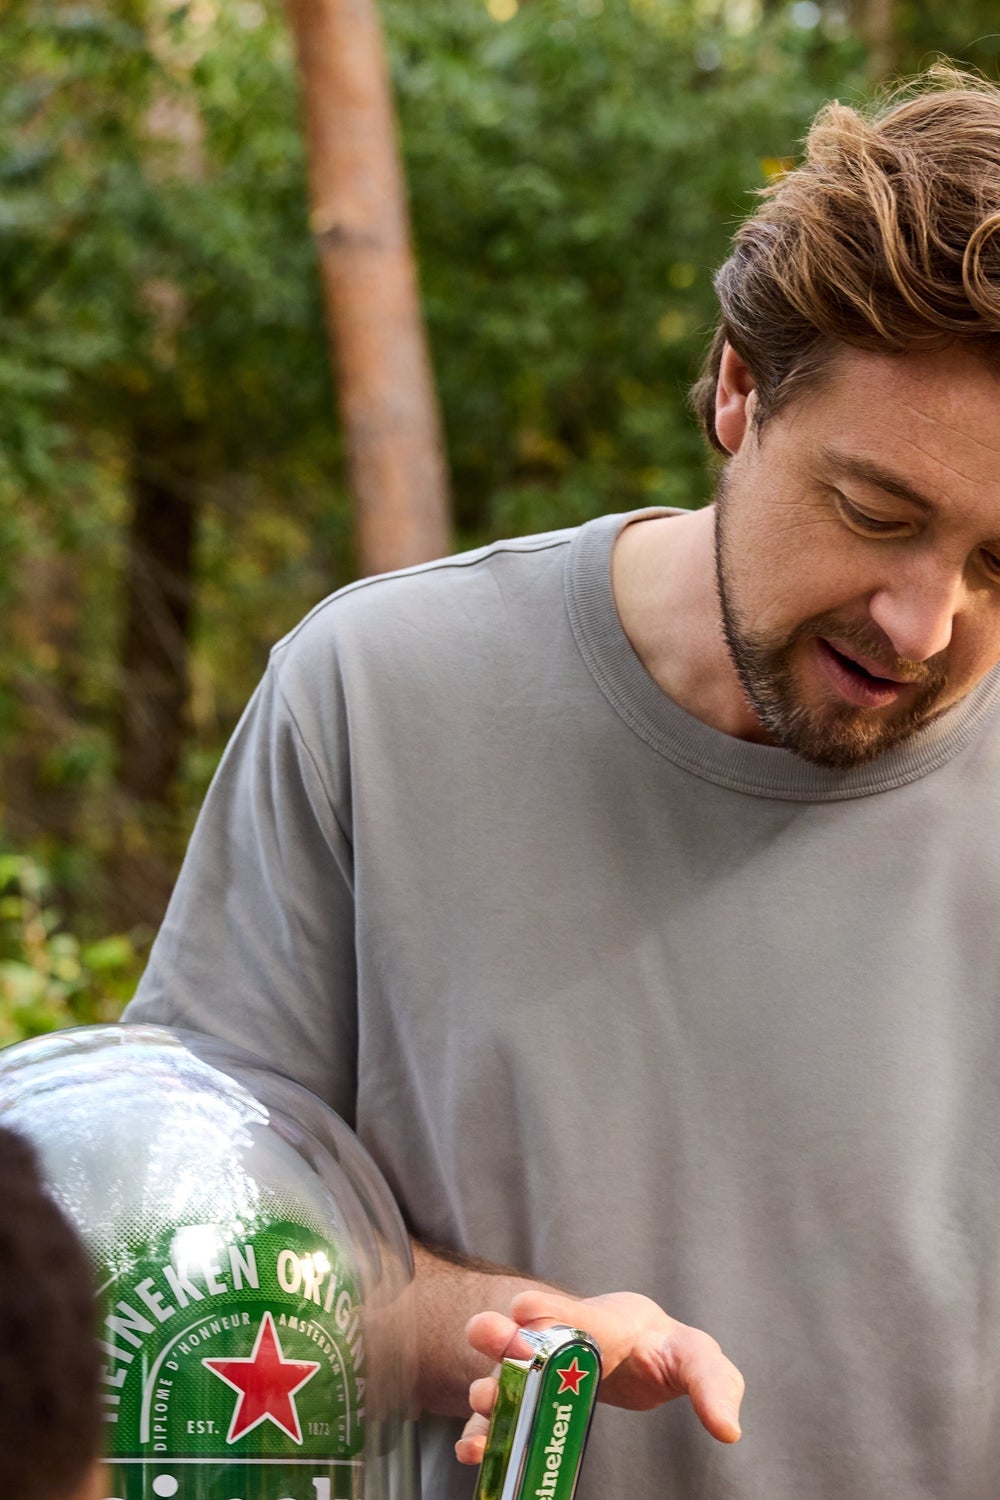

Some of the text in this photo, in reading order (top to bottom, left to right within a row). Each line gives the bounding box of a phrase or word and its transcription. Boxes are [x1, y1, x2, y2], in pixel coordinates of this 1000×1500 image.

[153, 1377, 174, 1451] DIPLOME
[165, 1312, 251, 1372] D'HONNEUR
[278, 1313, 341, 1376] AMSTERDAM
[187, 1420, 331, 1436] EST. 1873
